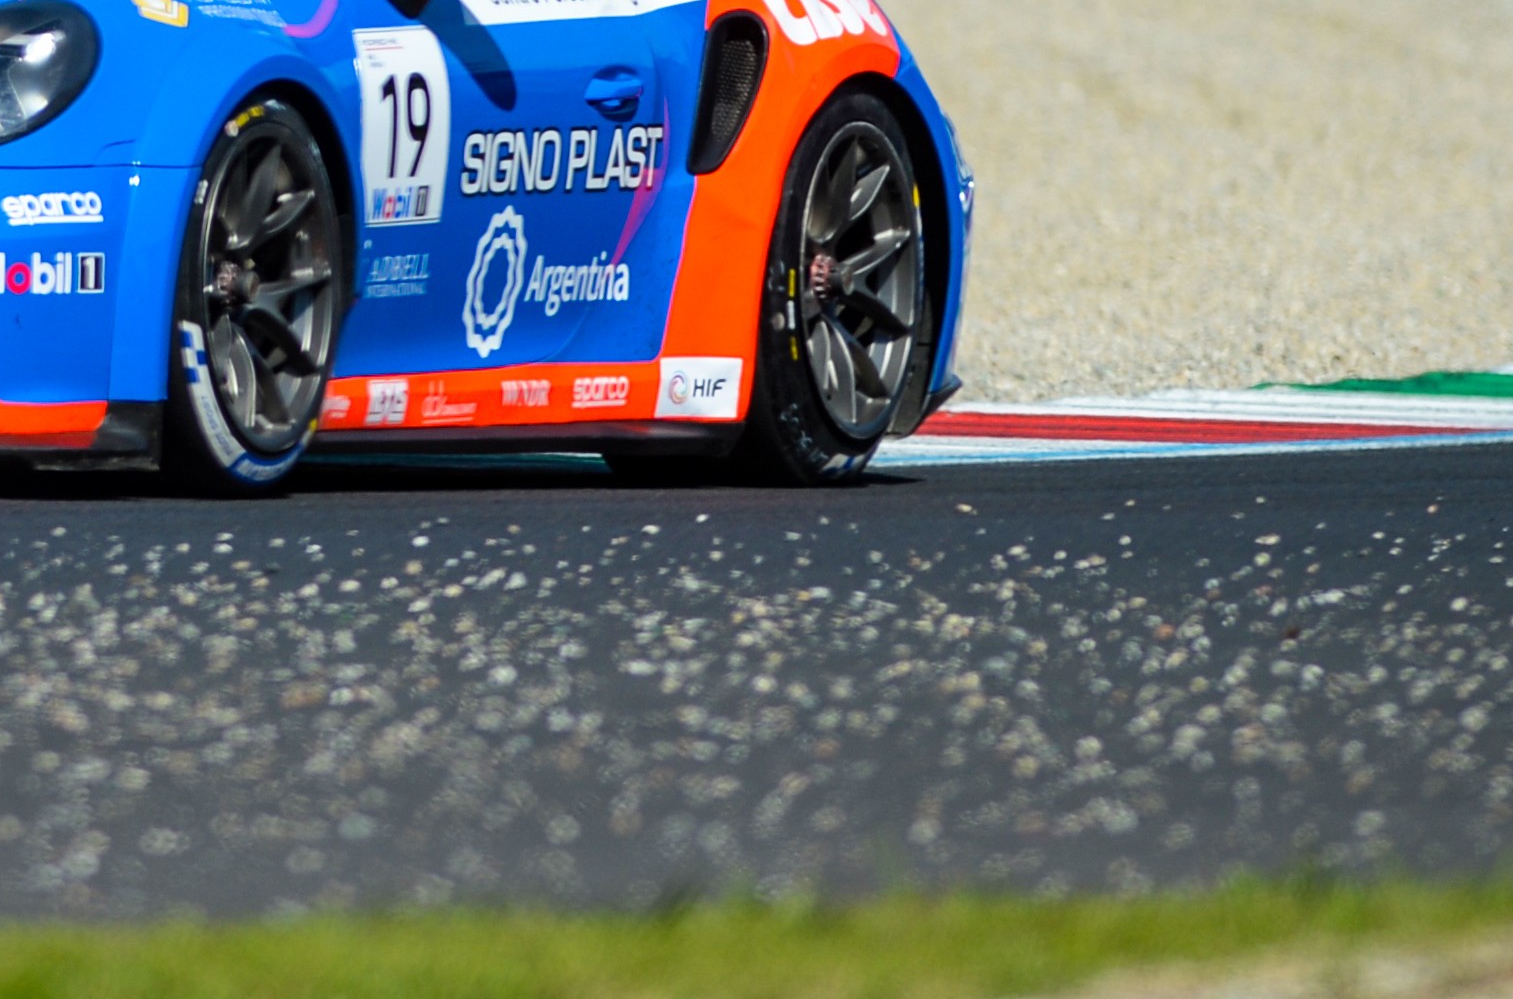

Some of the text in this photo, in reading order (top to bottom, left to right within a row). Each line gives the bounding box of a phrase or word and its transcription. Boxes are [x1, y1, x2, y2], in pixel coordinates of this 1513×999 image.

[381, 71, 432, 179] 19
[460, 125, 665, 196] SIGNO PLAST
[0, 191, 104, 226] sparco
[523, 250, 630, 317] Argentina
[572, 375, 629, 405] sparco
[692, 378, 727, 398] HIF
